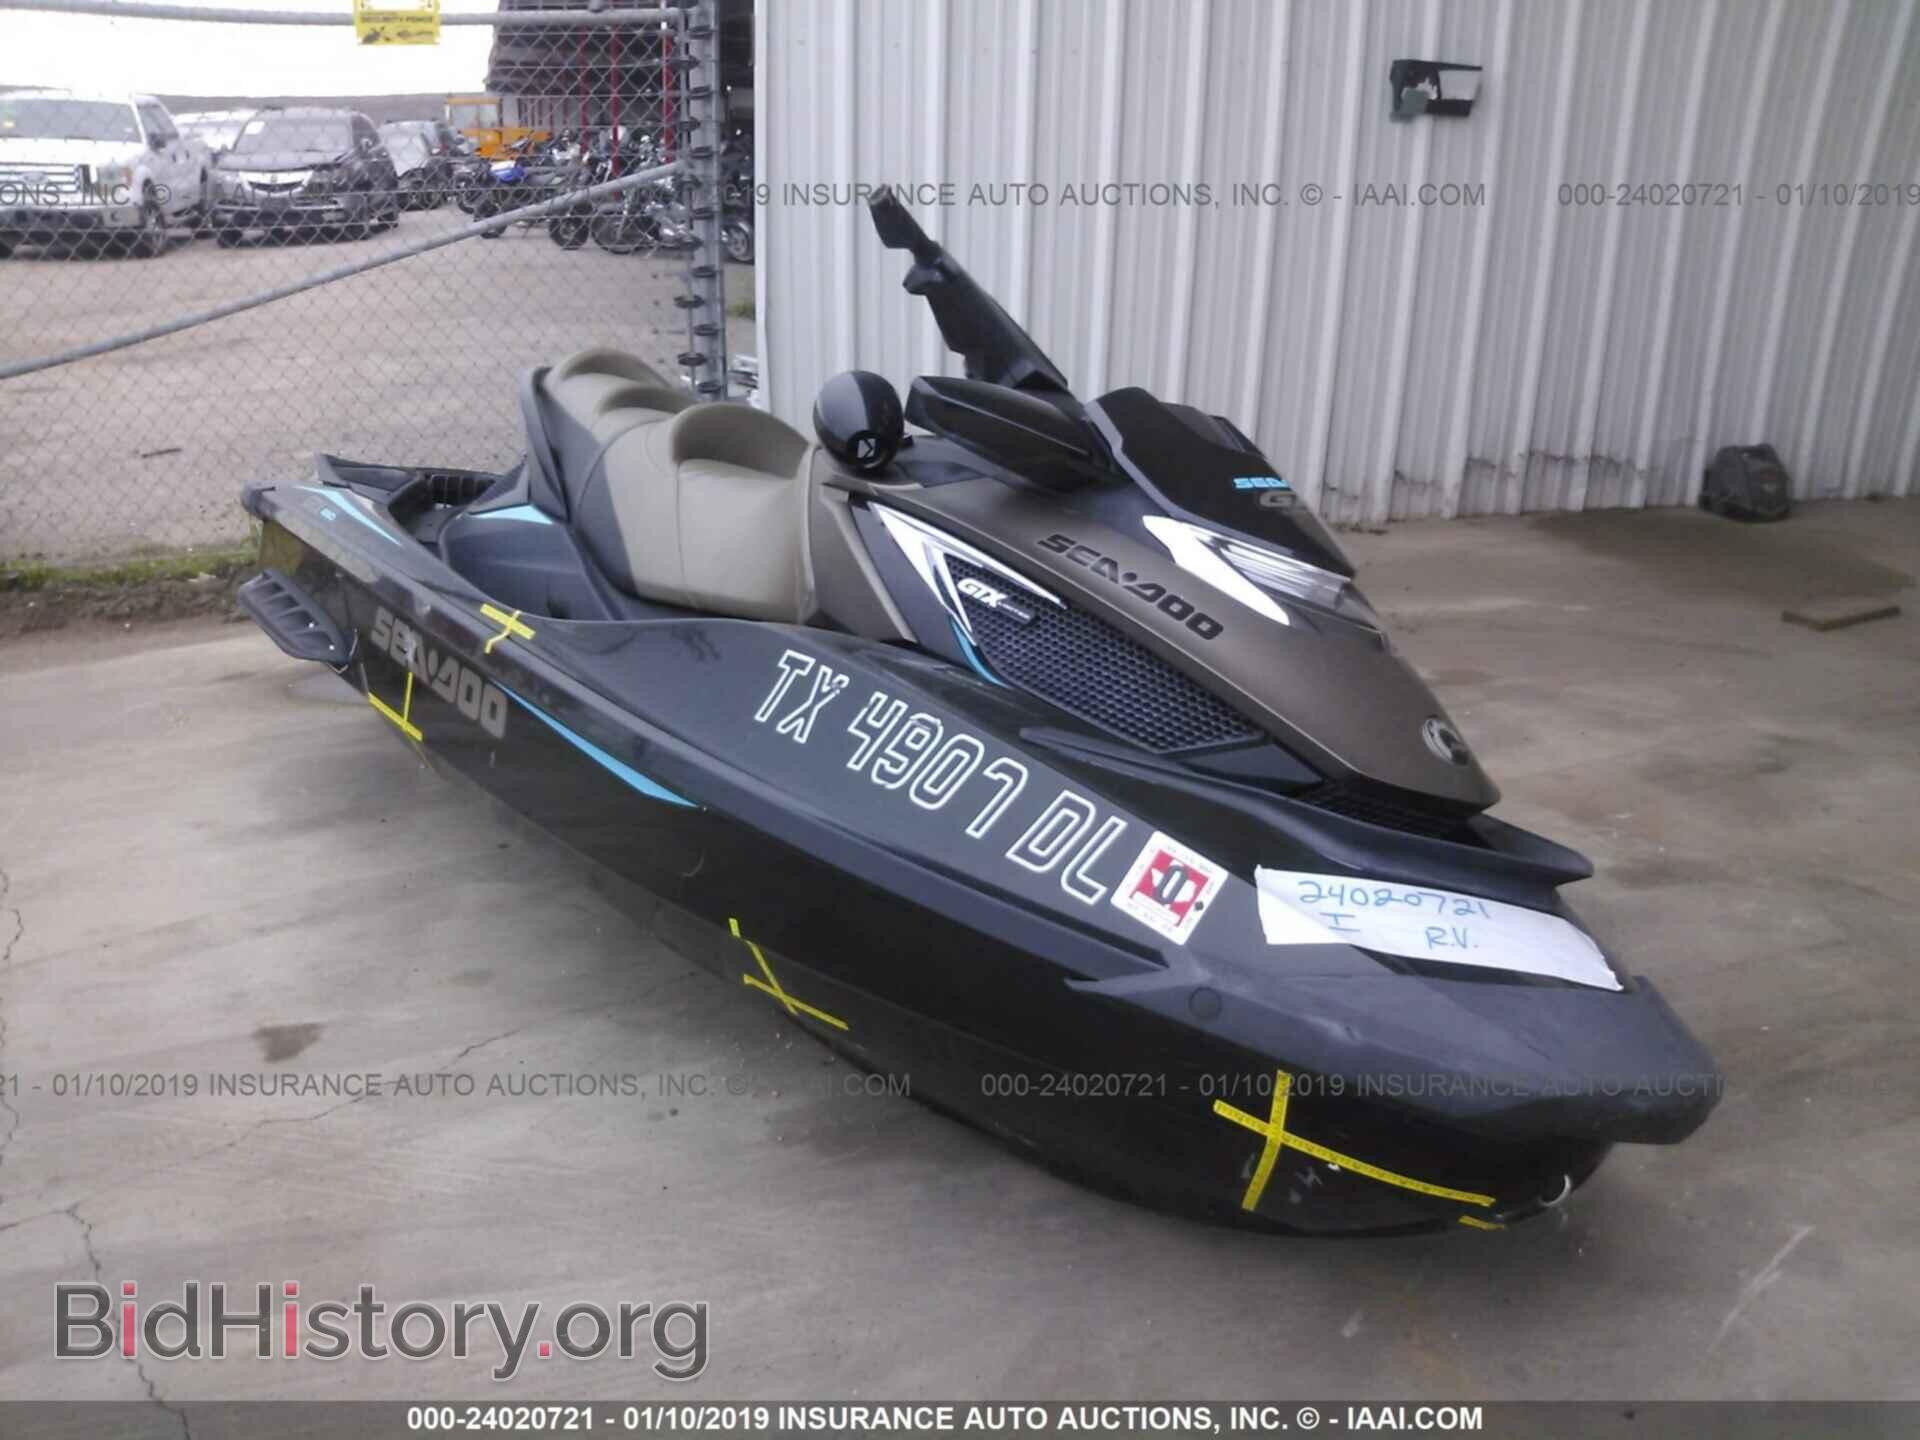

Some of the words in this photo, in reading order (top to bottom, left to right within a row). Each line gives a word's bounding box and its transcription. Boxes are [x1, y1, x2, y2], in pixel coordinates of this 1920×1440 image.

[754, 649, 850, 744] TX
[847, 691, 1029, 839] 4907
[1005, 789, 1128, 906] DL
[1298, 880, 1492, 919] 24020721
